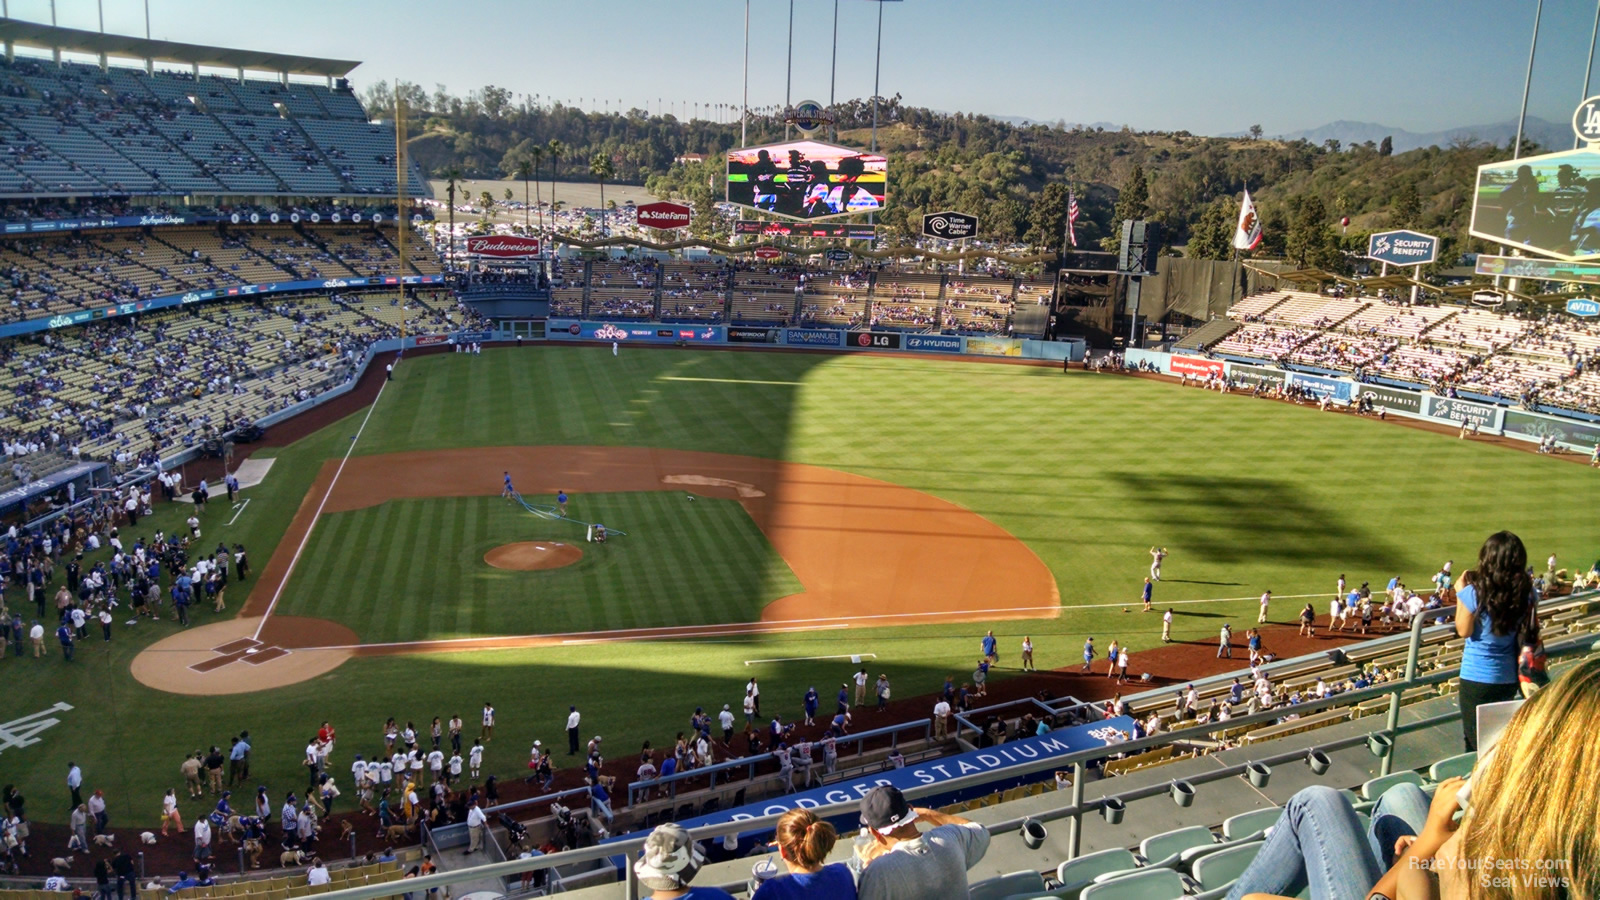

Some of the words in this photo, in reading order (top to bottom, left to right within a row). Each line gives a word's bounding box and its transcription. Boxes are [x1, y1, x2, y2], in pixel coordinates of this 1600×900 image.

[1583, 103, 1600, 134] LA
[470, 239, 538, 252] Budweiser
[1394, 238, 1431, 250] SECURITY
[1570, 303, 1597, 313] AVITA
[809, 332, 839, 340] MANUEL
[874, 336, 890, 346] LG
[923, 340, 960, 348] HYUNDAI
[1452, 402, 1492, 416] SECURITY
[913, 737, 1070, 784] STADIUM
